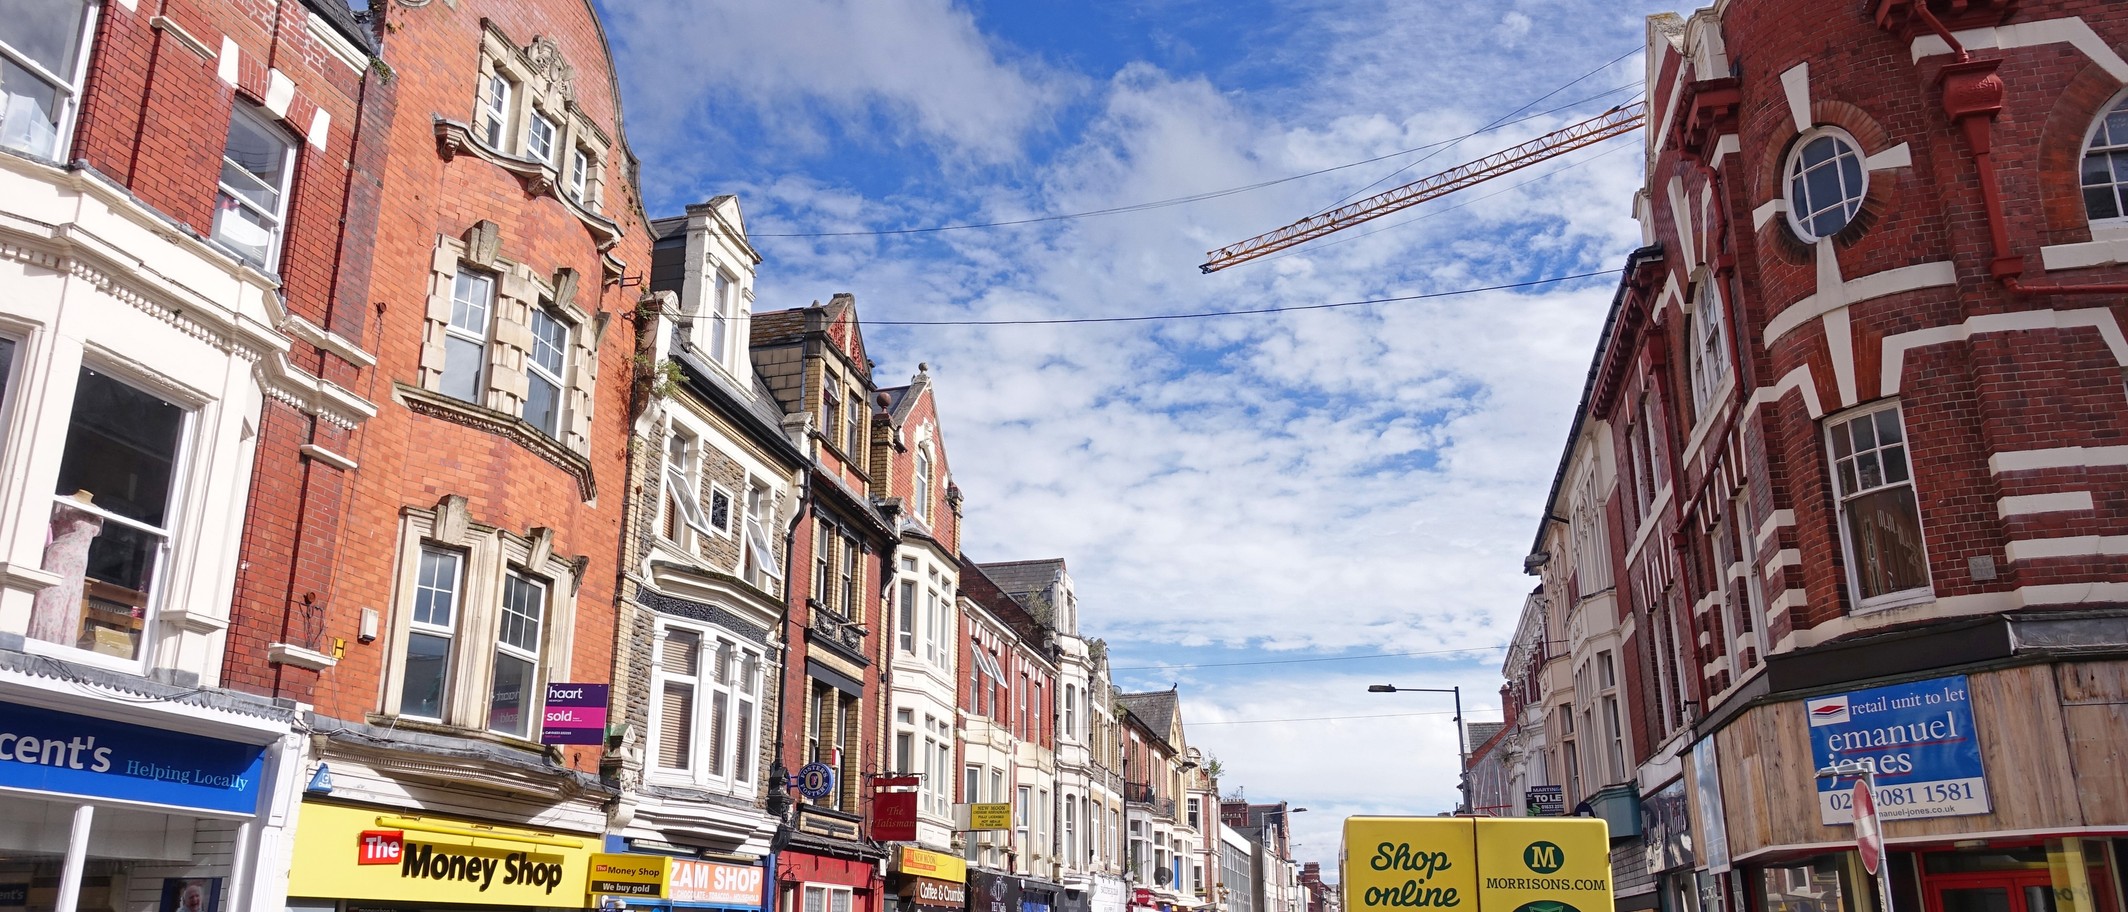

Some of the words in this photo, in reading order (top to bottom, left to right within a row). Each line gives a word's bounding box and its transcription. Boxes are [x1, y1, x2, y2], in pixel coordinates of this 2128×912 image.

[549, 686, 583, 699] haart
[1851, 696, 1887, 715] retail
[1890, 692, 1921, 710] unit
[1925, 693, 1941, 705] to
[1945, 687, 1966, 702] let
[546, 710, 572, 722] sold
[1828, 711, 1958, 752] emanuel
[125, 759, 190, 784] Helping
[193, 768, 248, 791] Locally
[800, 765, 828, 778] FOSTER'S
[800, 781, 828, 796] FOSTER'S
[1830, 792, 1853, 810] 02
[1924, 782, 1974, 803] 1581
[1534, 794, 1548, 802] TO
[1549, 794, 1562, 802] LE
[886, 805, 903, 816] The
[1851, 805, 1956, 818] manuel-jones.co.uk
[874, 818, 915, 829] Talisman
[1370, 842, 1452, 879] Shop
[1531, 846, 1556, 868] M
[365, 836, 400, 859] The
[402, 843, 499, 892] Money
[503, 851, 563, 895] Shop
[607, 866, 636, 877] Money
[638, 867, 660, 878] Shop
[714, 866, 760, 892] SHOP
[1486, 877, 1606, 891] MORRISONS.COM
[602, 882, 615, 891] We
[615, 883, 631, 893] buy
[632, 884, 650, 893] gold
[920, 881, 938, 900] Coffee
[938, 884, 944, 901] &
[943, 885, 965, 902] Crumbs
[1364, 878, 1461, 907] online
